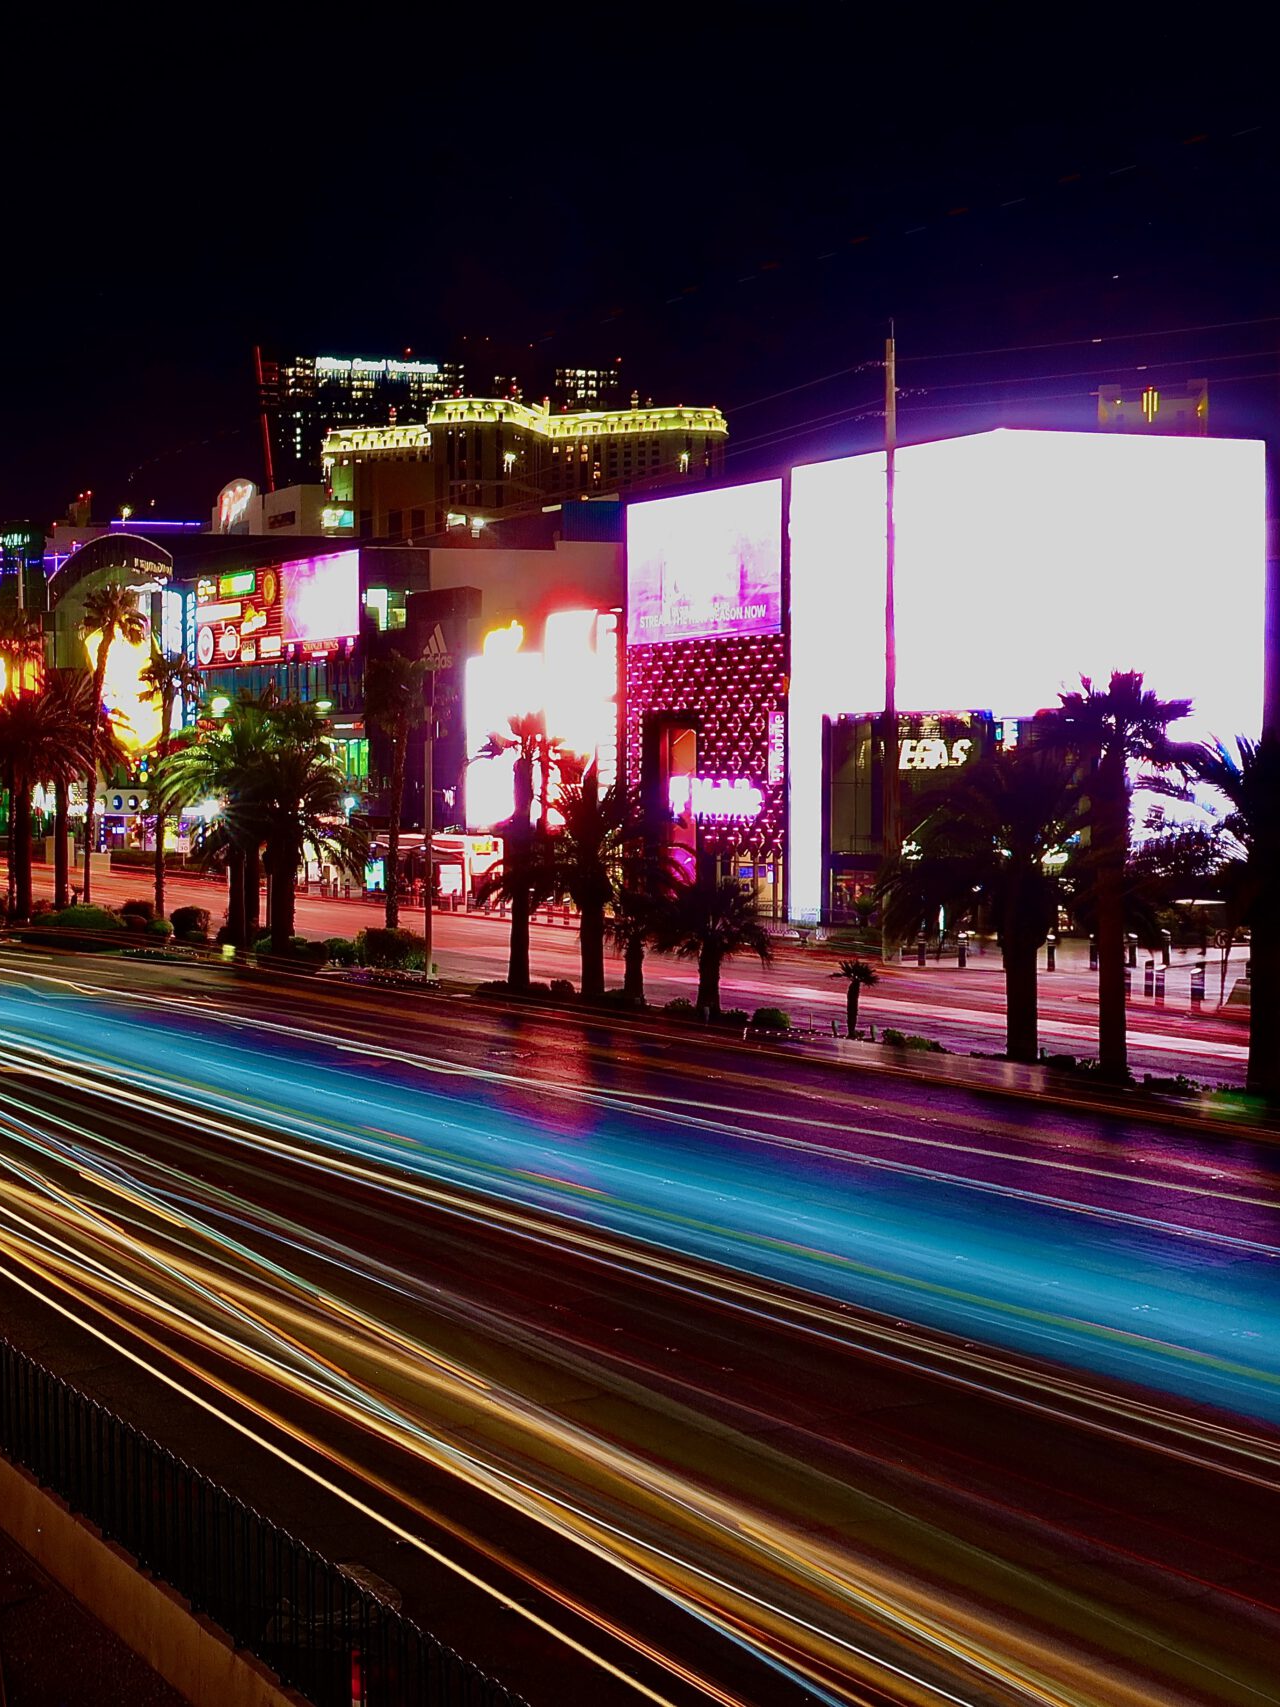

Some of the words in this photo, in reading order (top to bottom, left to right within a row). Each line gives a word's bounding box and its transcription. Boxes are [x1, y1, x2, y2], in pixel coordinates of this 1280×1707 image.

[640, 612, 671, 629] STREA
[744, 604, 767, 619] NOW
[892, 738, 973, 769] EGAS
